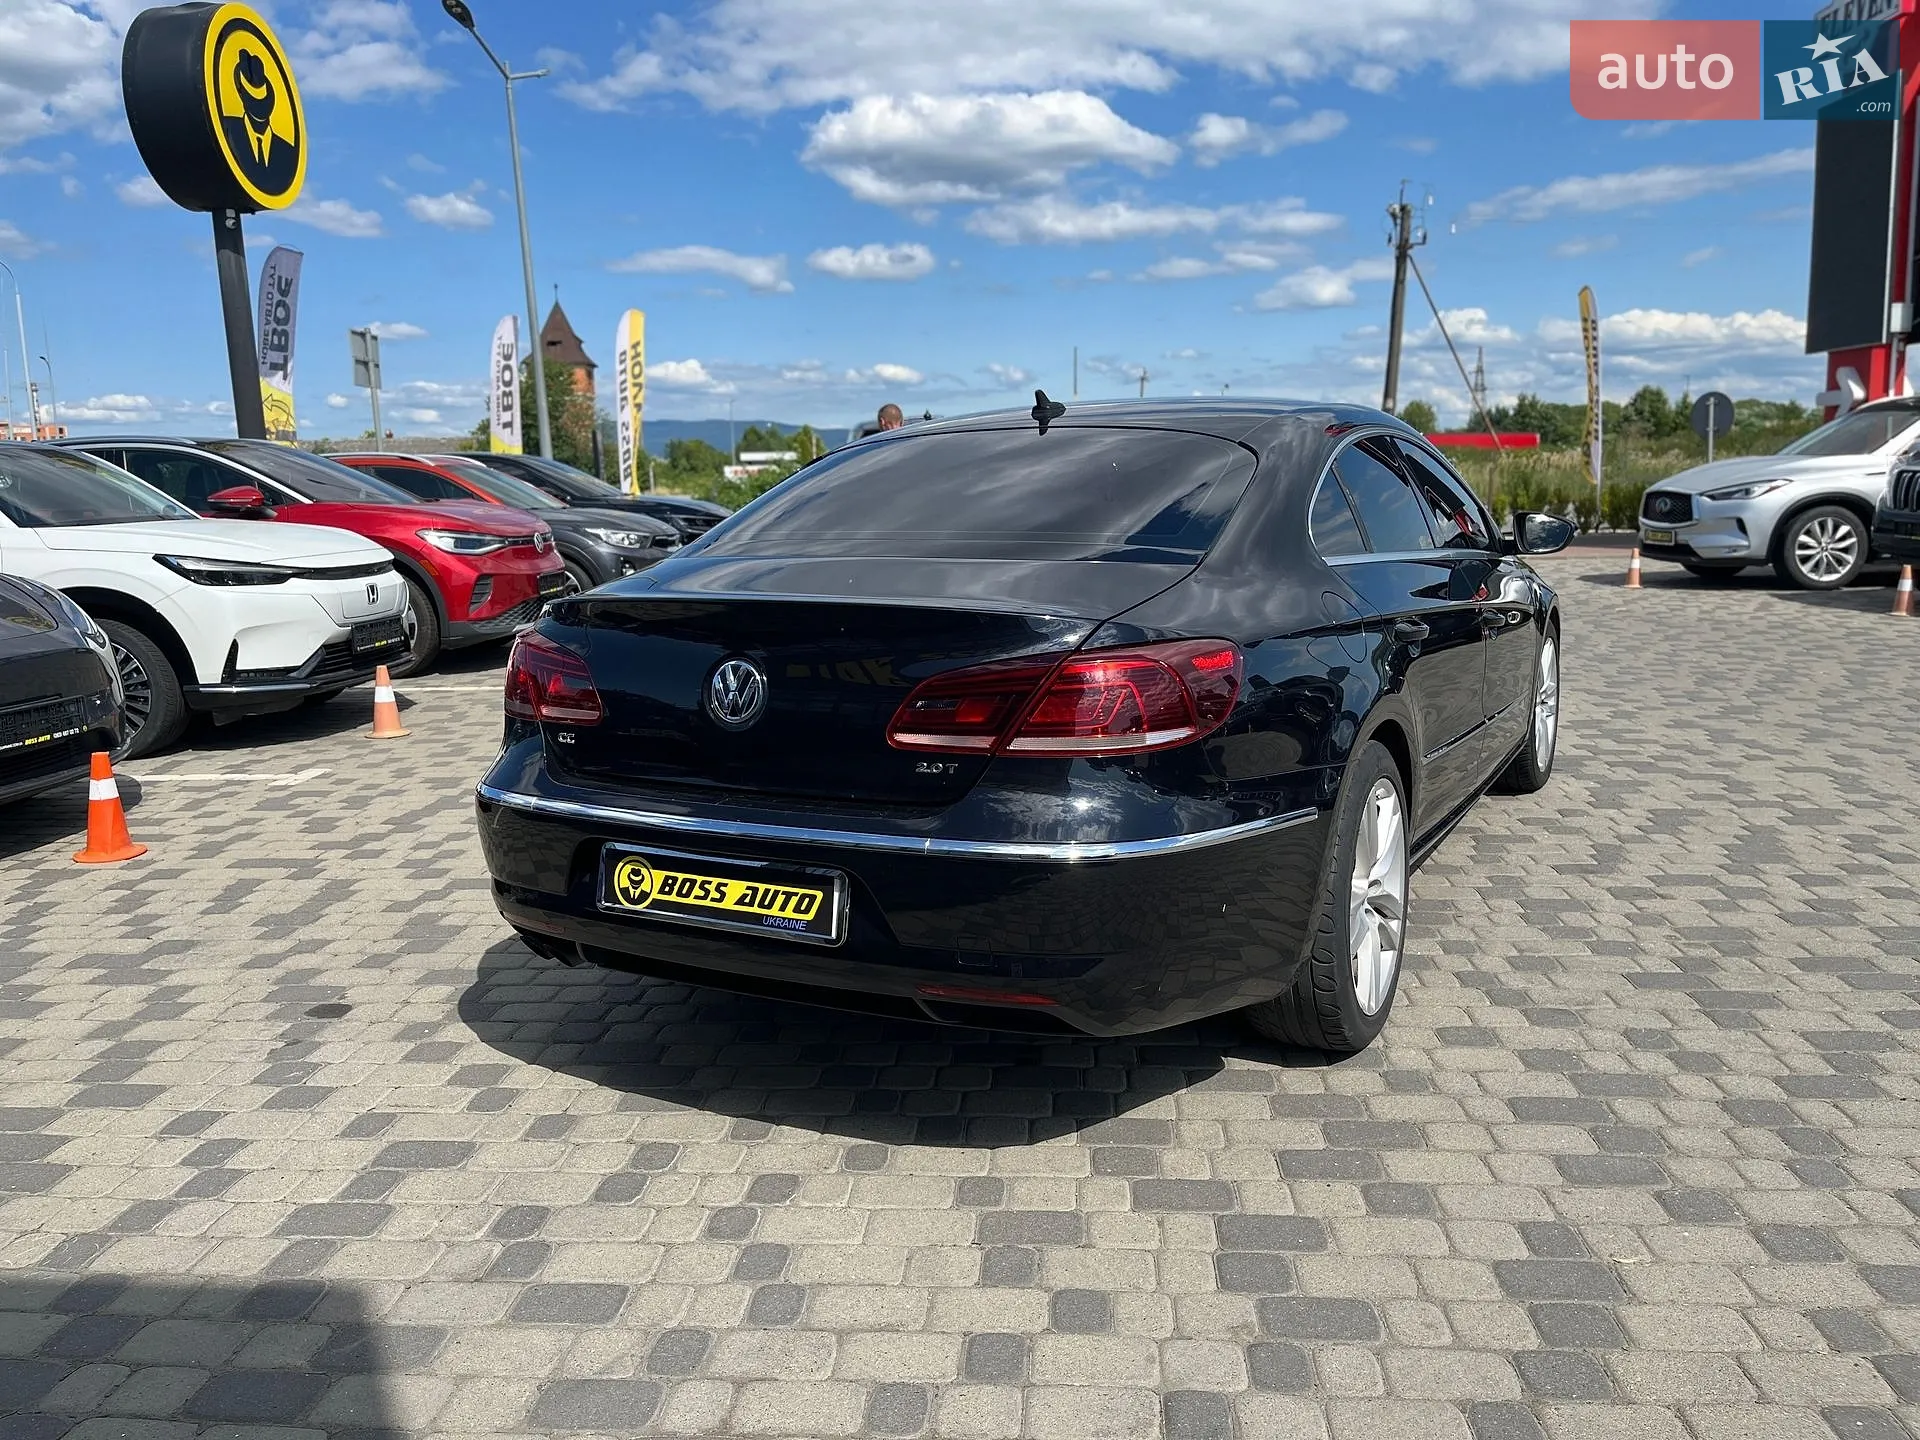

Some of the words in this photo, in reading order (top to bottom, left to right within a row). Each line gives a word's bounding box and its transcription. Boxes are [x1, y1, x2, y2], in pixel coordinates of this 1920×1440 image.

[558, 732, 575, 744] CC
[657, 874, 729, 903] BOSS
[733, 885, 818, 915] AUTO
[762, 915, 808, 931] UKRAINE
